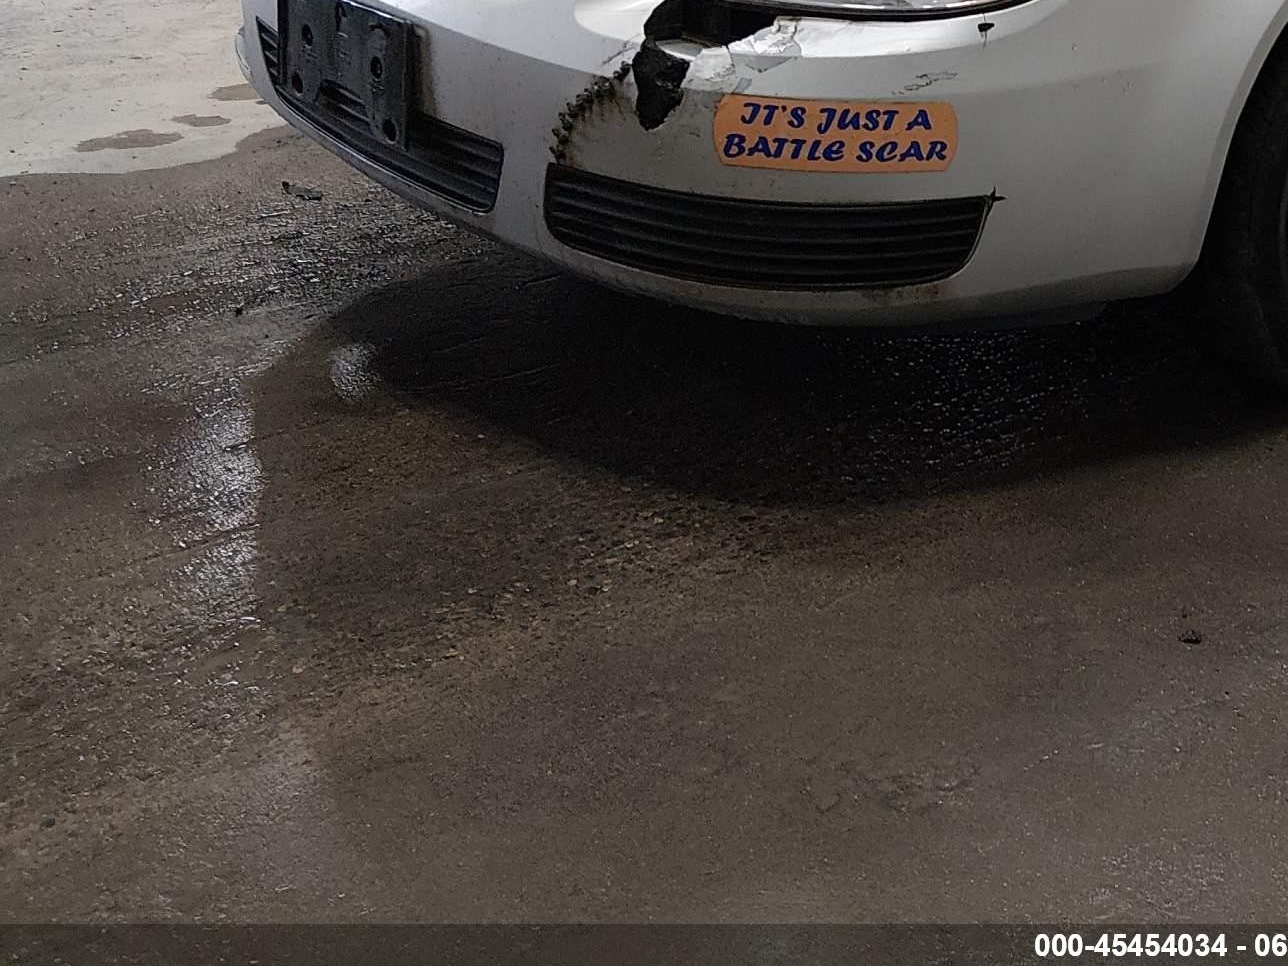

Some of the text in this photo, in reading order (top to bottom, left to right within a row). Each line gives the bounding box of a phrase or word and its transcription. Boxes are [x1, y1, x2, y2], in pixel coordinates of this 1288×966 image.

[740, 102, 932, 134] IT'S JUST A
[723, 133, 948, 163] BATTLE SCAR
